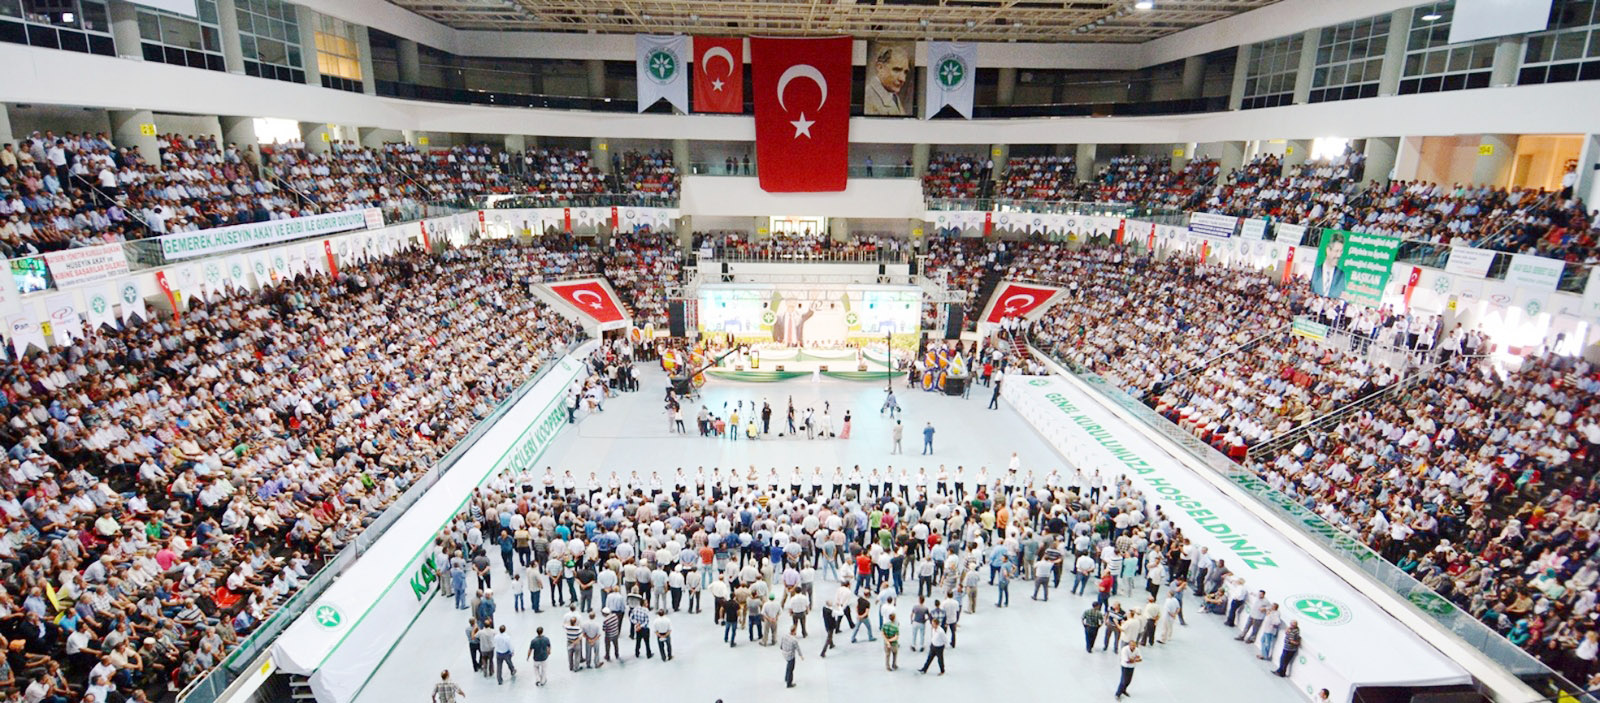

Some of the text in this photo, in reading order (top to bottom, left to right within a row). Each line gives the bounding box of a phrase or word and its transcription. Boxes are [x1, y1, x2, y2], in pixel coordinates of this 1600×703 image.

[254, 225, 272, 240] AKAY
[276, 223, 284, 236] VE
[316, 217, 336, 230] GURUR
[92, 257, 106, 265] AKAY
[1045, 392, 1080, 414] GENEL
[1070, 414, 1155, 475] KURULUMUZA
[1144, 478, 1279, 569] HOŞGELDİNİZ
[410, 552, 438, 602] KAY
